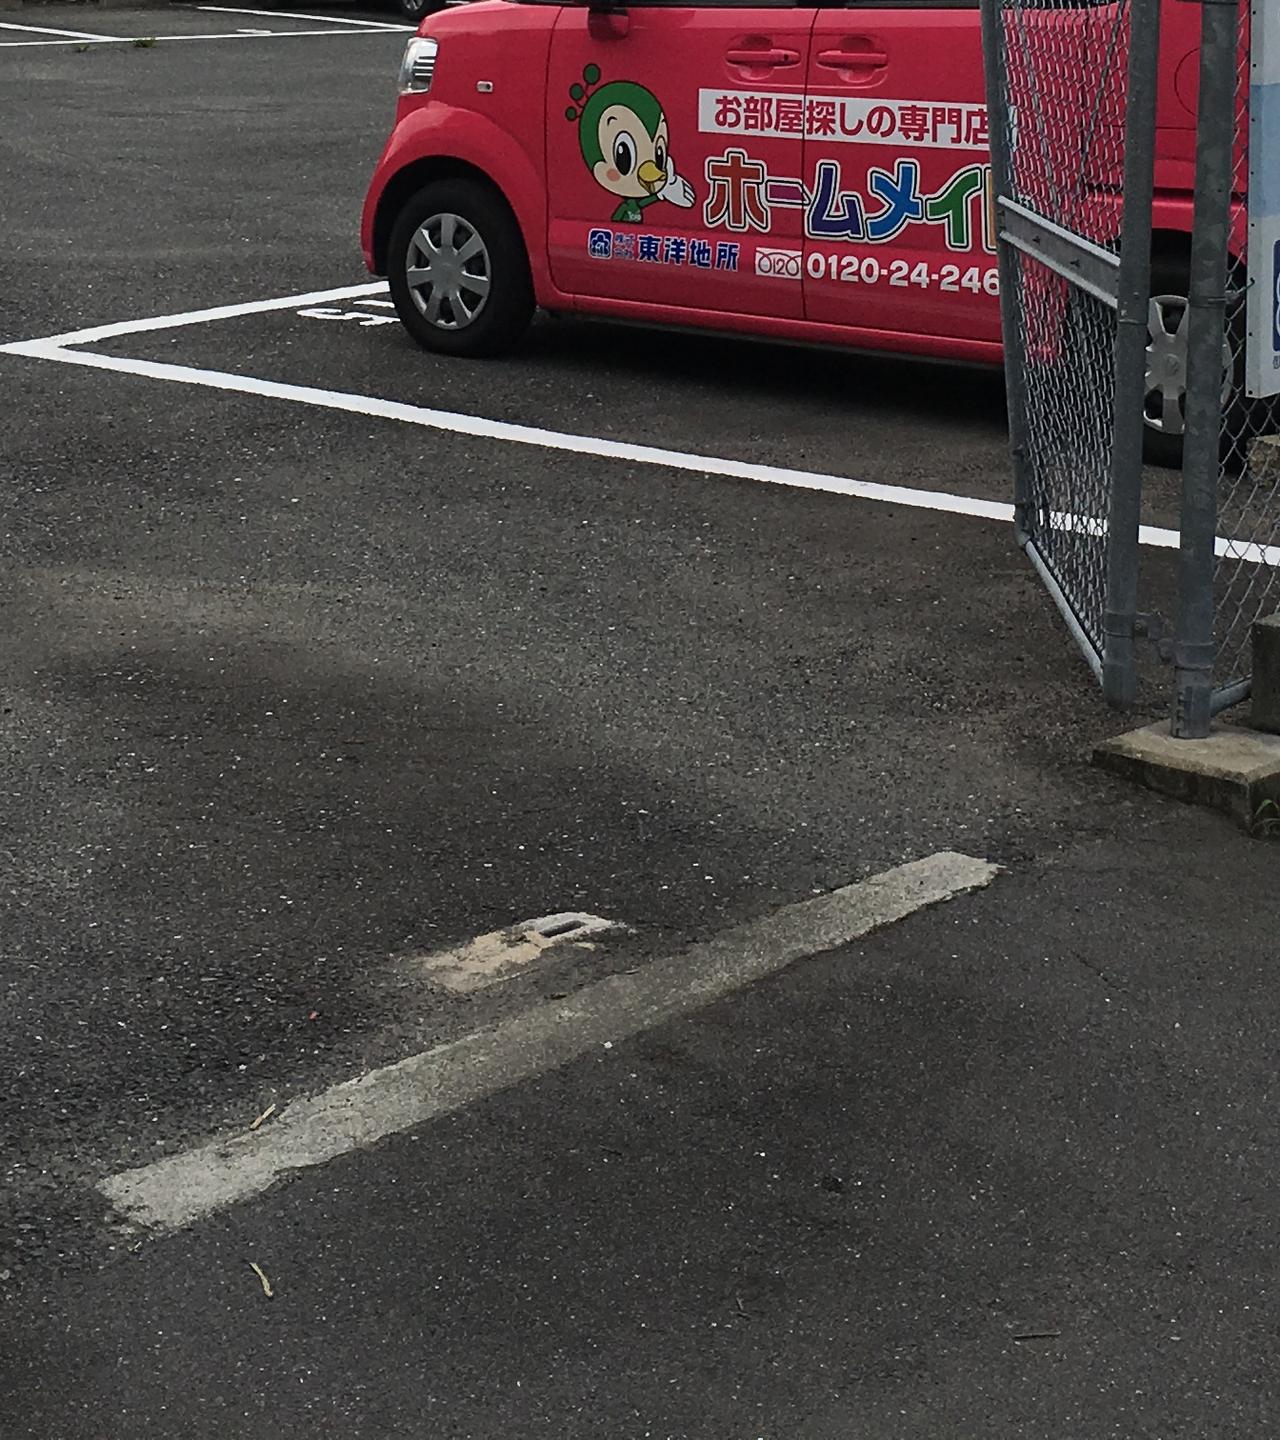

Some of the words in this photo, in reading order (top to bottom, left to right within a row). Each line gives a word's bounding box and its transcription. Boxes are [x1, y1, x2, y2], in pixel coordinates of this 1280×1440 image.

[714, 96, 990, 144] お部屋探しの専門店
[703, 149, 1000, 254] ホームメイ
[638, 234, 740, 272] 東洋地所
